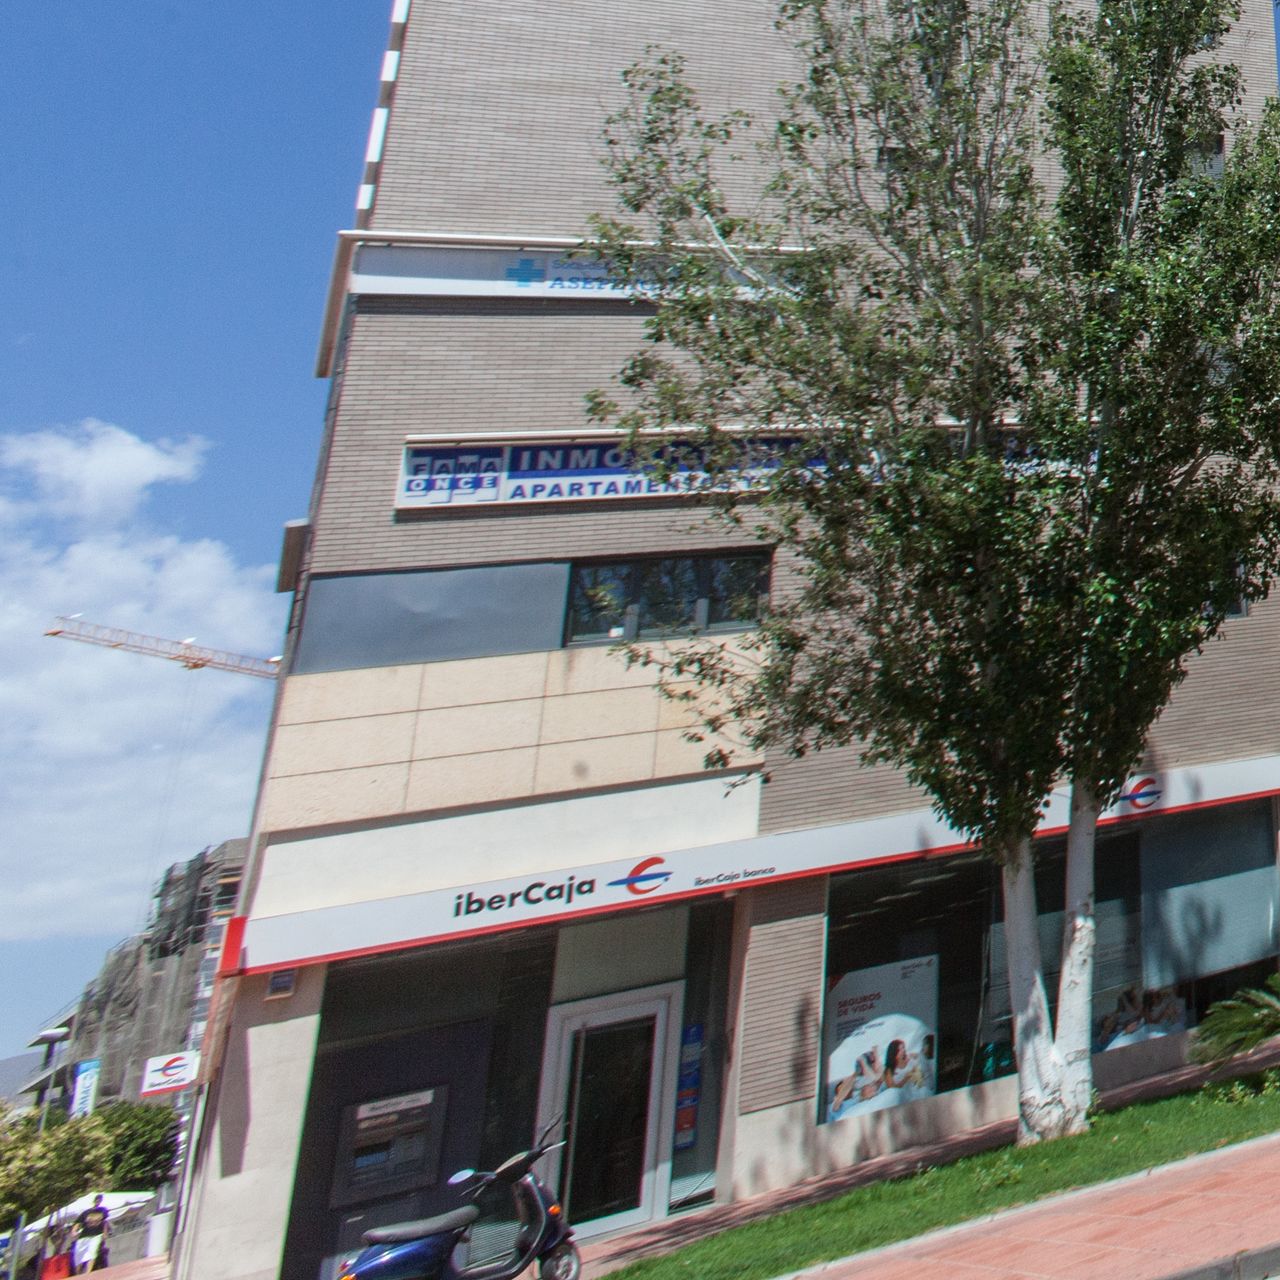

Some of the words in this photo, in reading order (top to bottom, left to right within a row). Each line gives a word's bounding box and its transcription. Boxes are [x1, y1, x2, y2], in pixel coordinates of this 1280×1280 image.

[415, 461, 498, 476] FAMA
[410, 477, 496, 491] ONCE
[694, 871, 741, 887] iberCaja
[453, 875, 597, 918] iberCaja
[838, 992, 881, 1008] SEGUROS
[853, 1003, 874, 1014] VIDA
